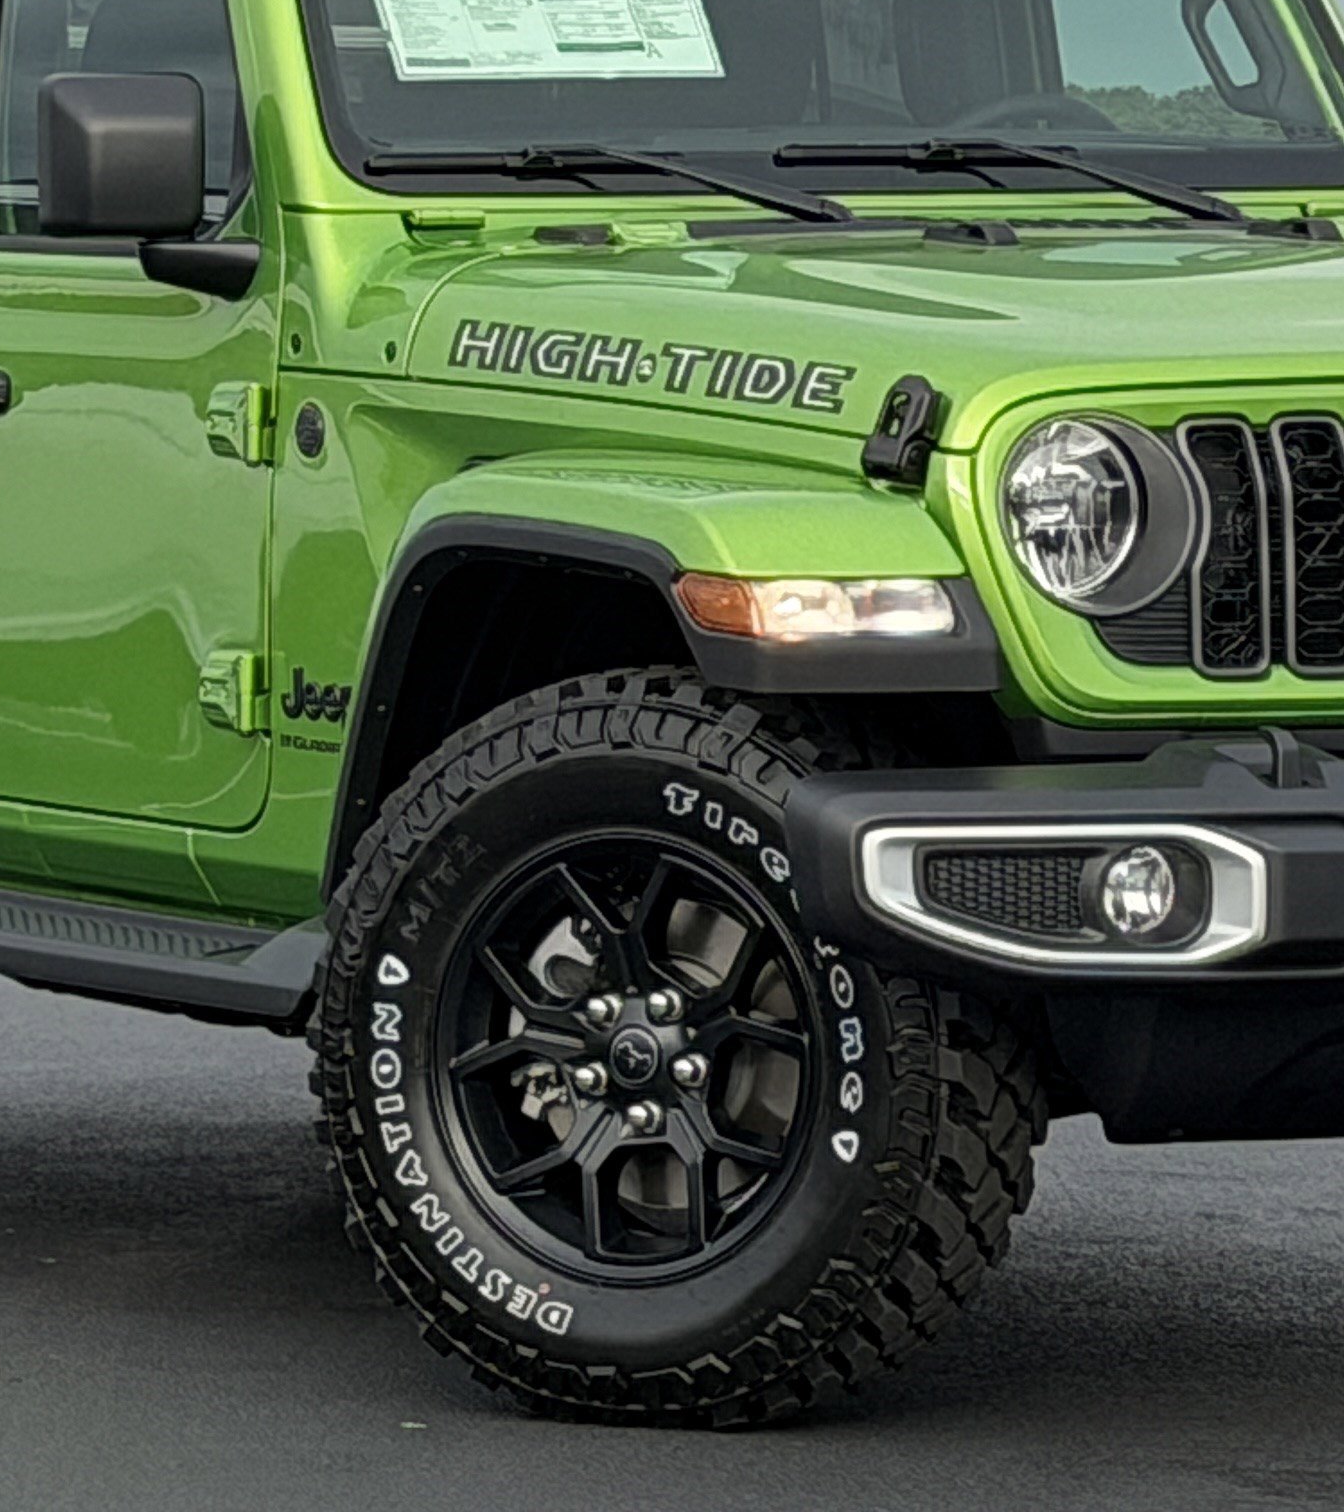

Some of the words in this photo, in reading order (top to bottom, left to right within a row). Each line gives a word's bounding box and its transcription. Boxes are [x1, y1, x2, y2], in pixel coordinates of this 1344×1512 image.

[448, 319, 643, 387] HIGH
[660, 342, 858, 414] TIDE
[662, 781, 865, 1115] Fireone
[369, 1000, 575, 1338] DESTINATION
